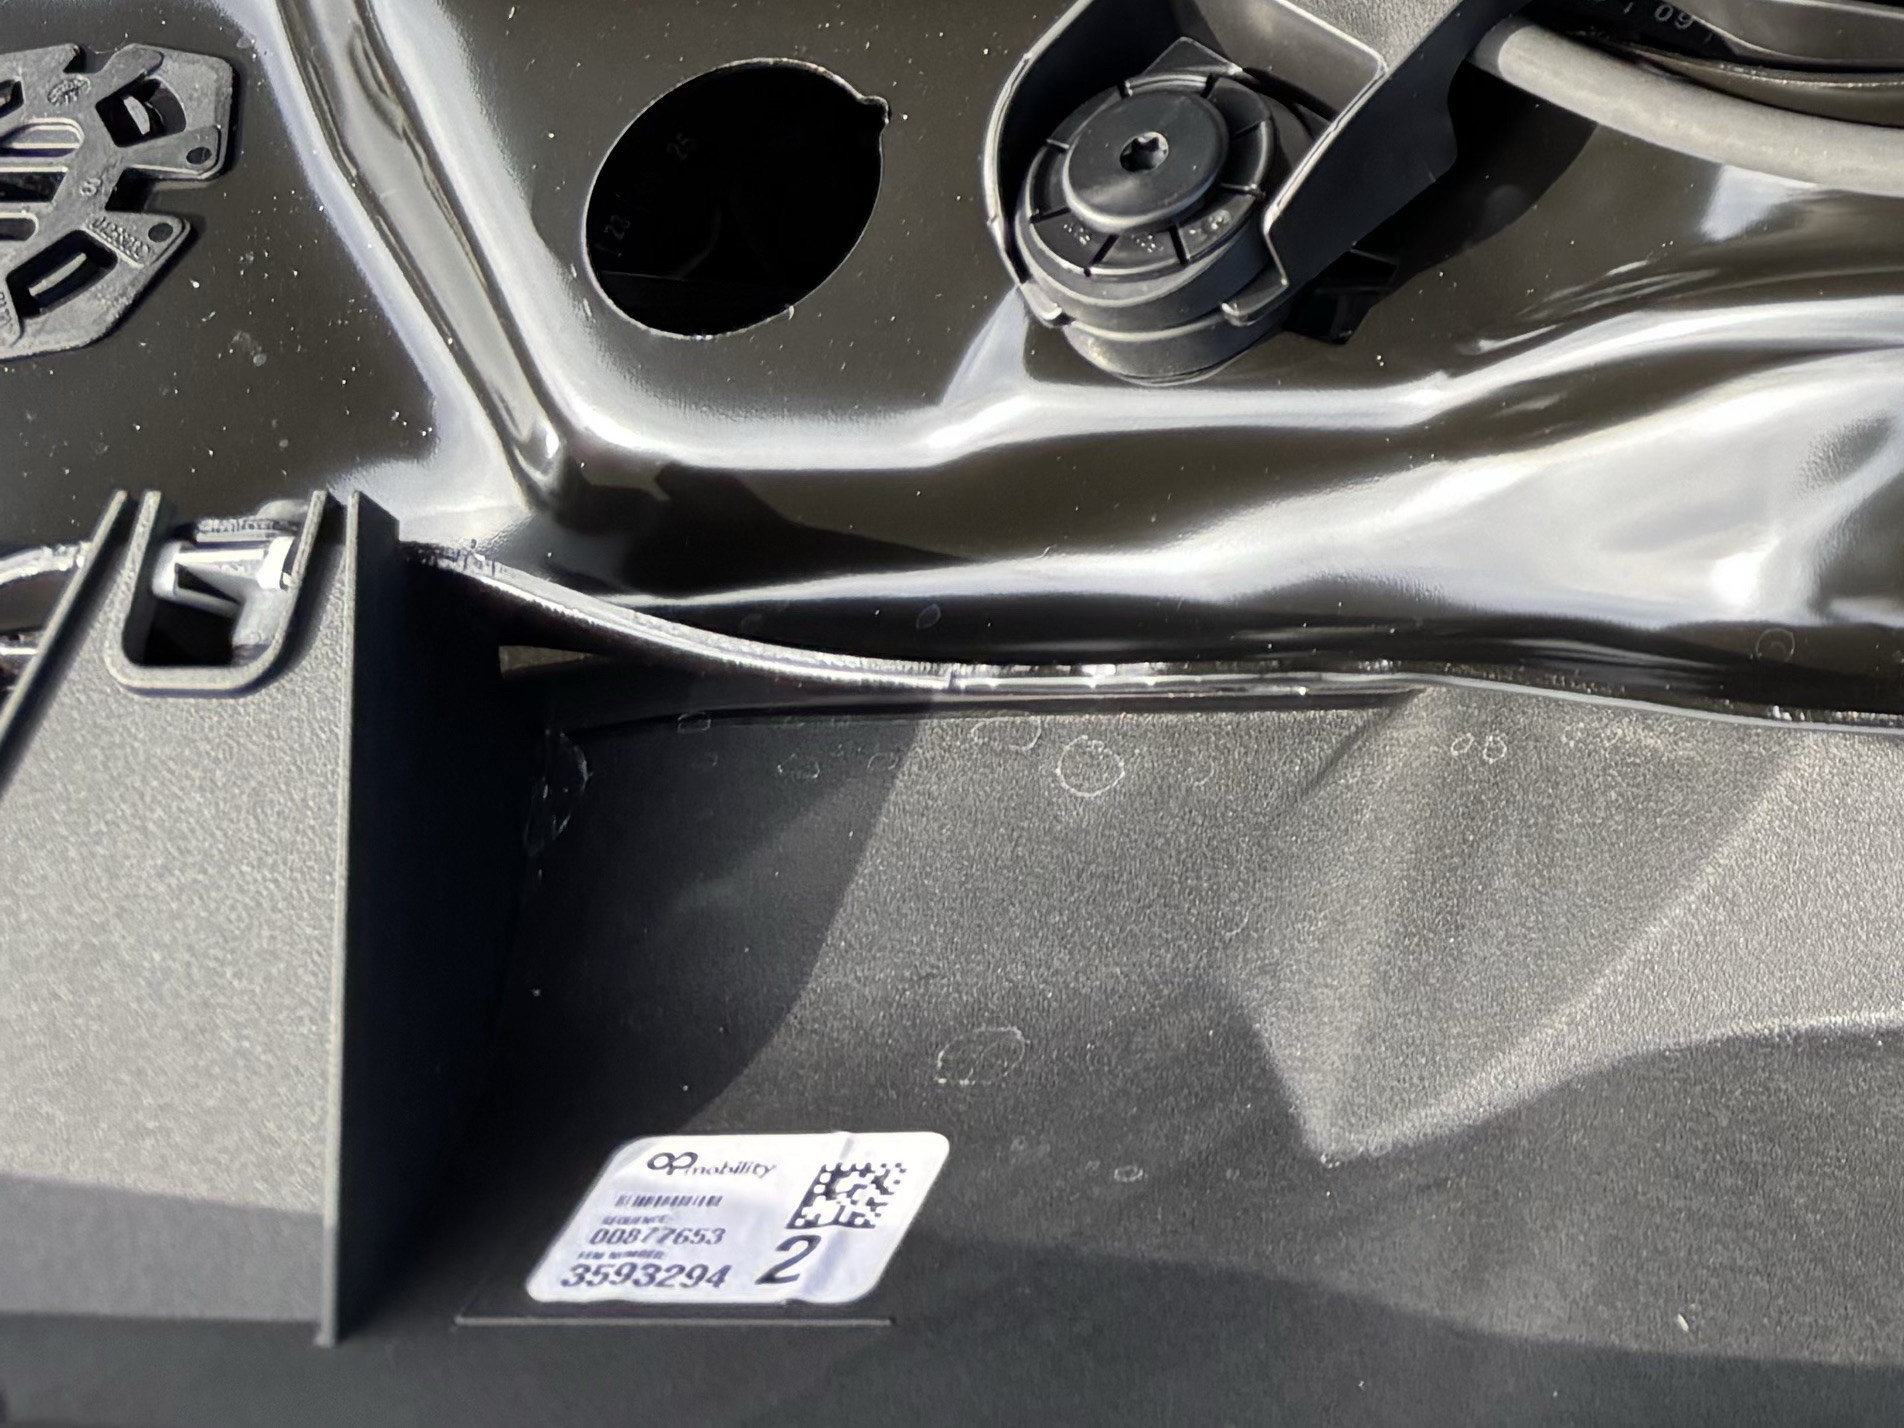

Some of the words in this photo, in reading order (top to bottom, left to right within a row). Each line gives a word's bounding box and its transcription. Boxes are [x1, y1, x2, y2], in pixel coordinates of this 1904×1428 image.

[589, 1227, 726, 1245] 00877653
[561, 1262, 732, 1288] 3593294
[755, 1235, 822, 1285] 2
